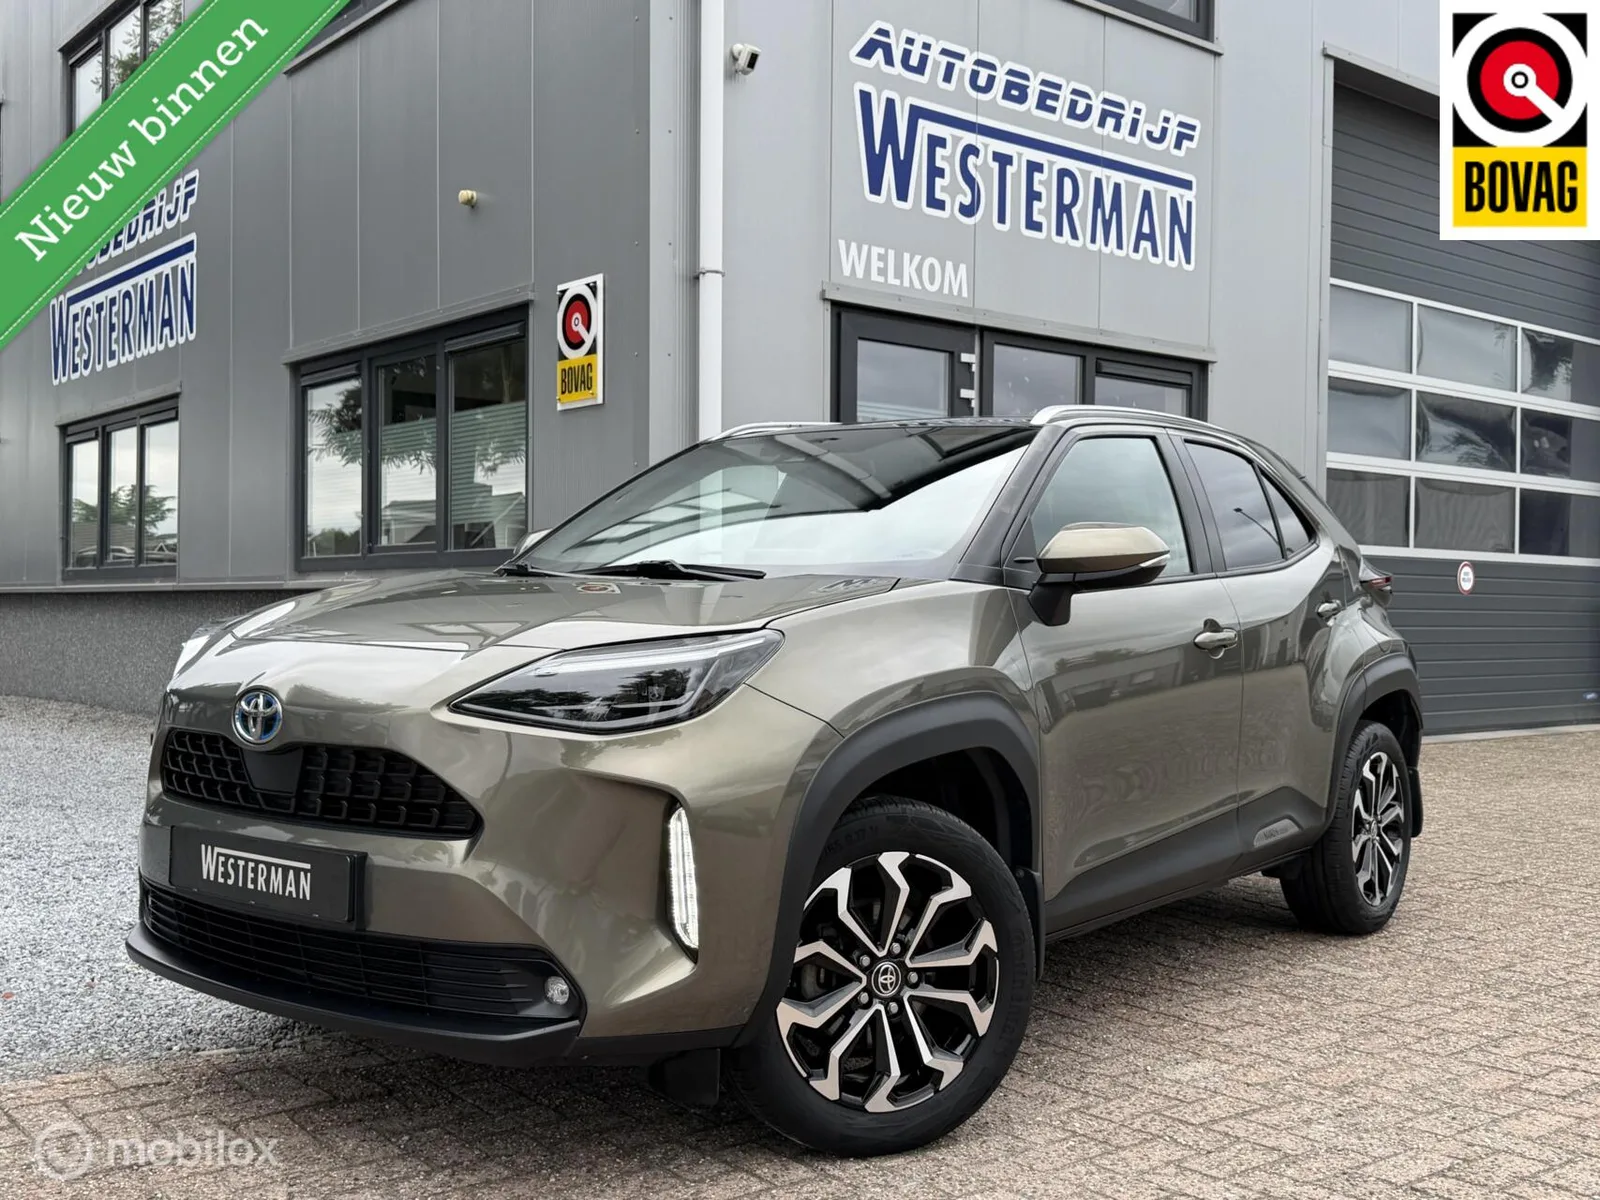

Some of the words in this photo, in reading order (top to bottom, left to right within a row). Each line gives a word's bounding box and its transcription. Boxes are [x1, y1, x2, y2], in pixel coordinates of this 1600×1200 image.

[851, 22, 1199, 155] AUTOBEDRIJF
[855, 83, 1195, 269] WESTERMAN
[50, 233, 197, 385] WESTERMAN
[838, 239, 968, 298] WELKOM
[560, 362, 593, 395] BOVAG
[201, 844, 311, 900] WESTERMAN
